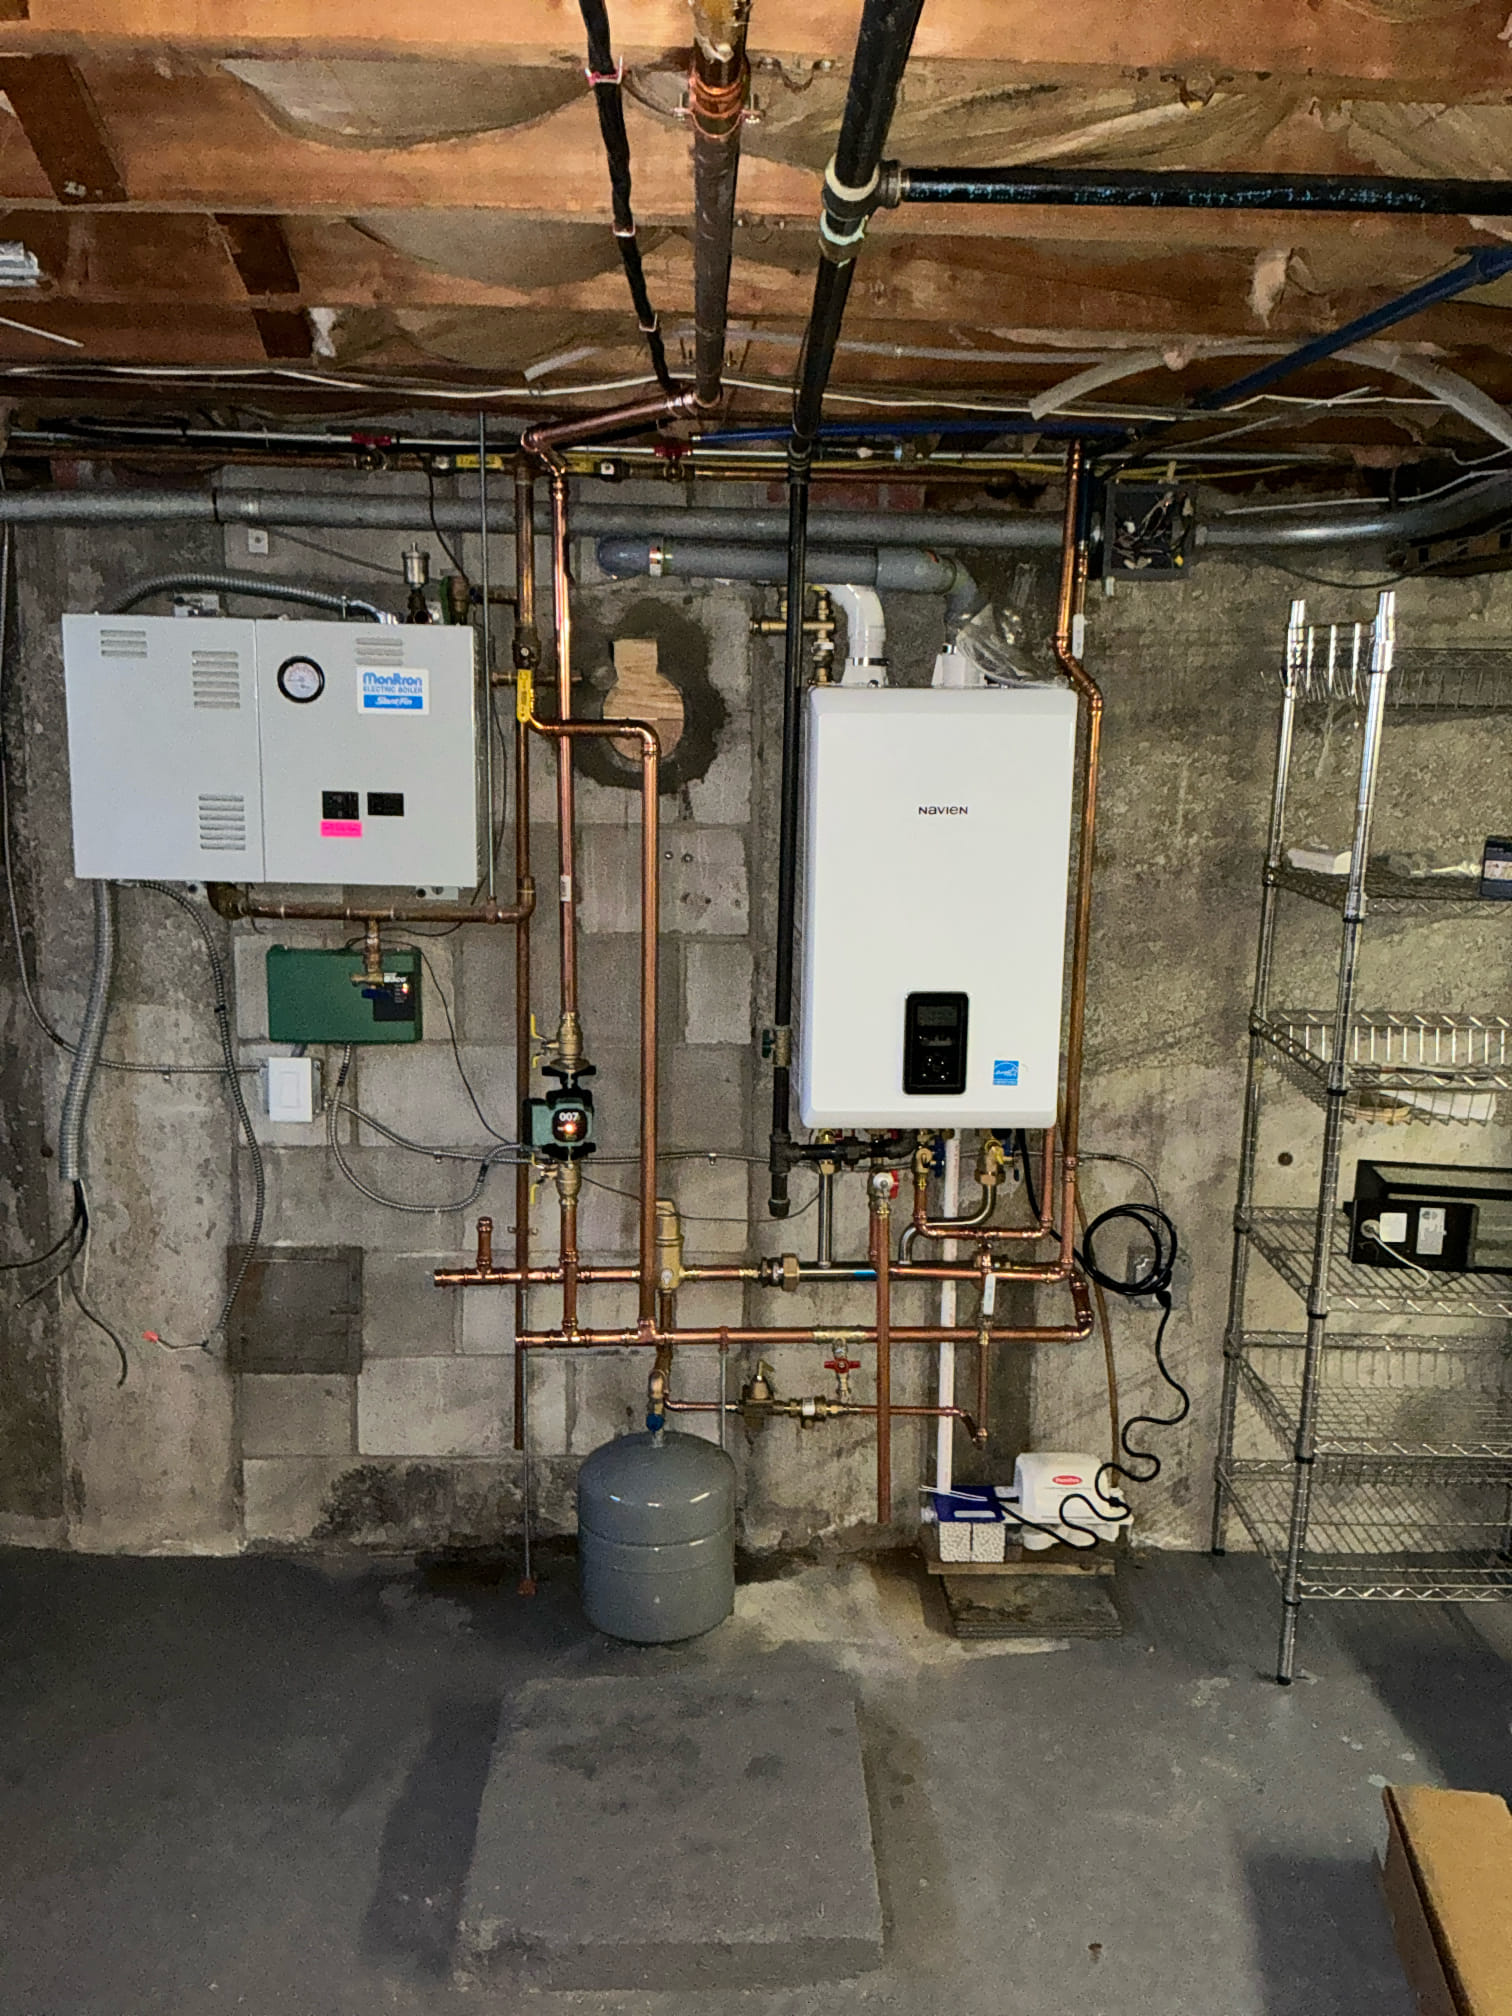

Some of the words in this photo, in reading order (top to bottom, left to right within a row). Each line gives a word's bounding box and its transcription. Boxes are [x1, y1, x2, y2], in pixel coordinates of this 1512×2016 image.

[363, 685, 396, 693] ELECTRIC
[398, 686, 423, 694] BOILER
[559, 1112, 580, 1121] 007
